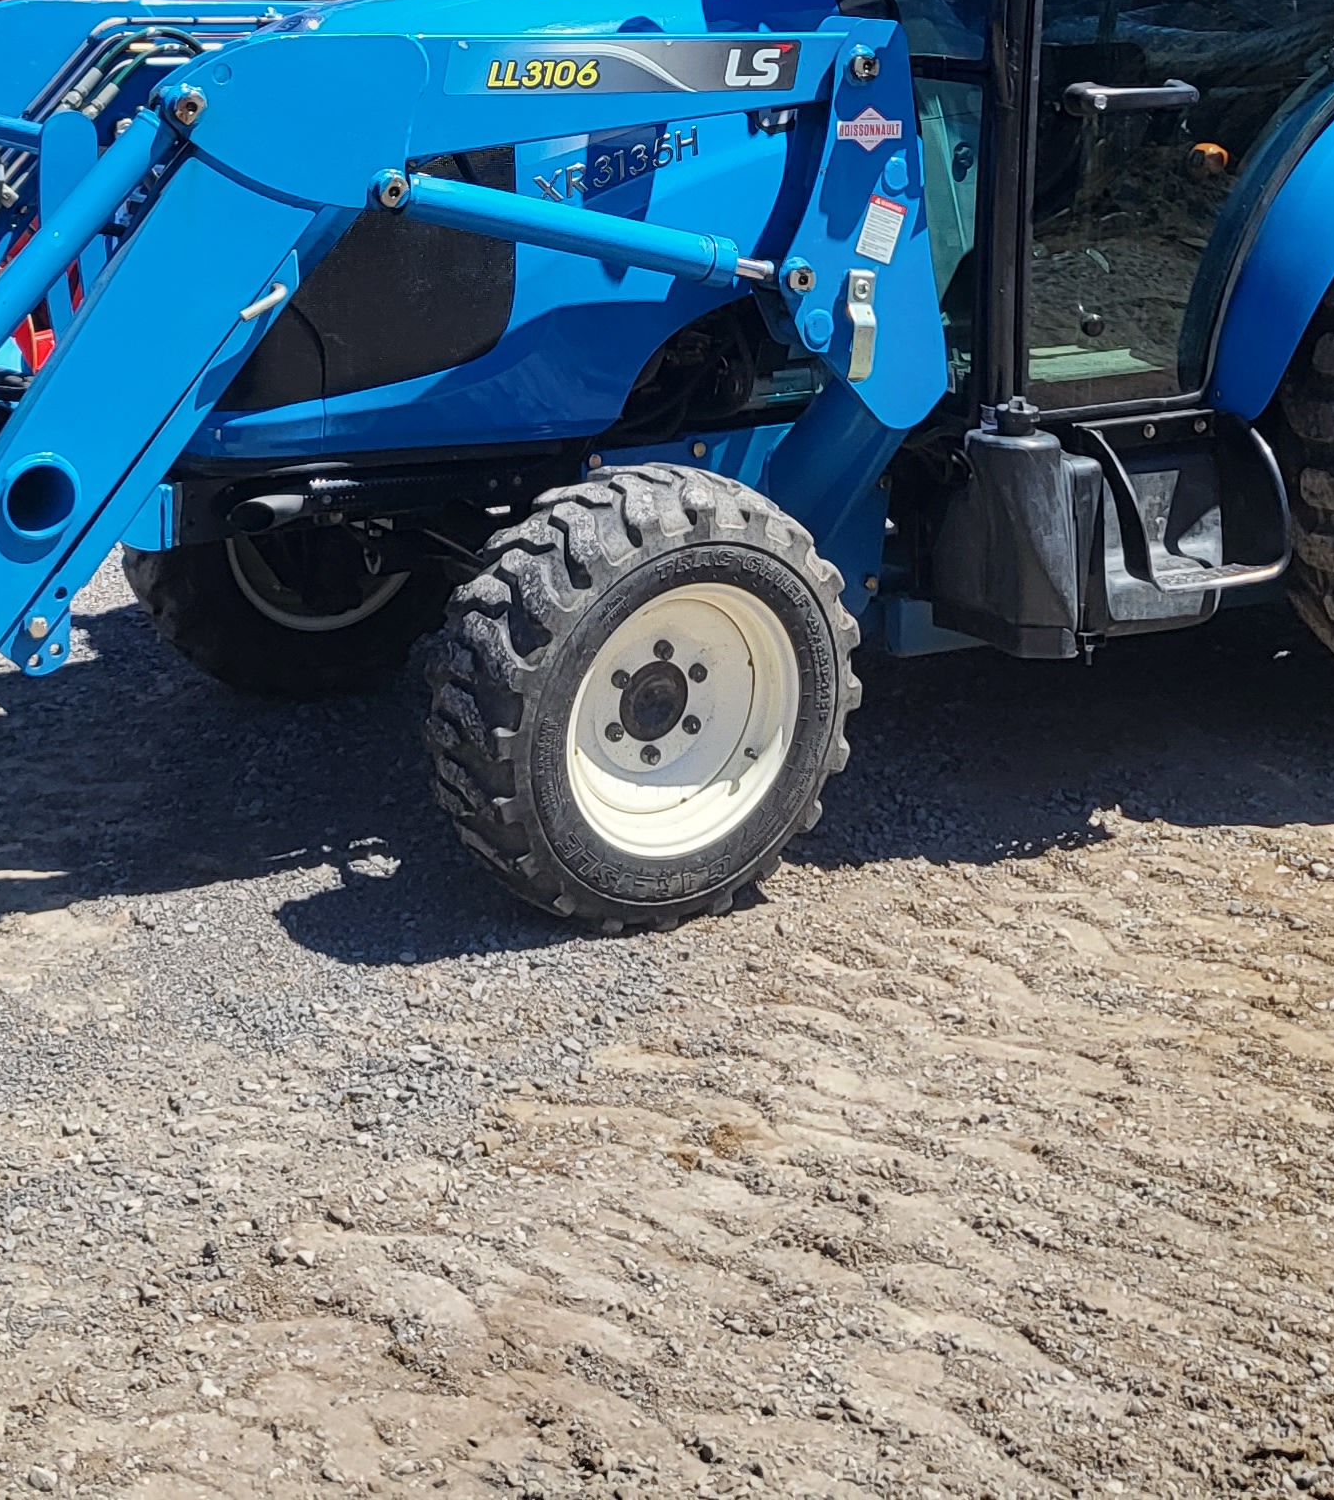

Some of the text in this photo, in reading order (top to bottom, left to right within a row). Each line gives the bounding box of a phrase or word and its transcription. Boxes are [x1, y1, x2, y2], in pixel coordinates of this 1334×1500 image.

[487, 48, 781, 88] LL3106 LS
[839, 124, 900, 137] BOISSONNAULT
[532, 125, 700, 202] XR3135H
